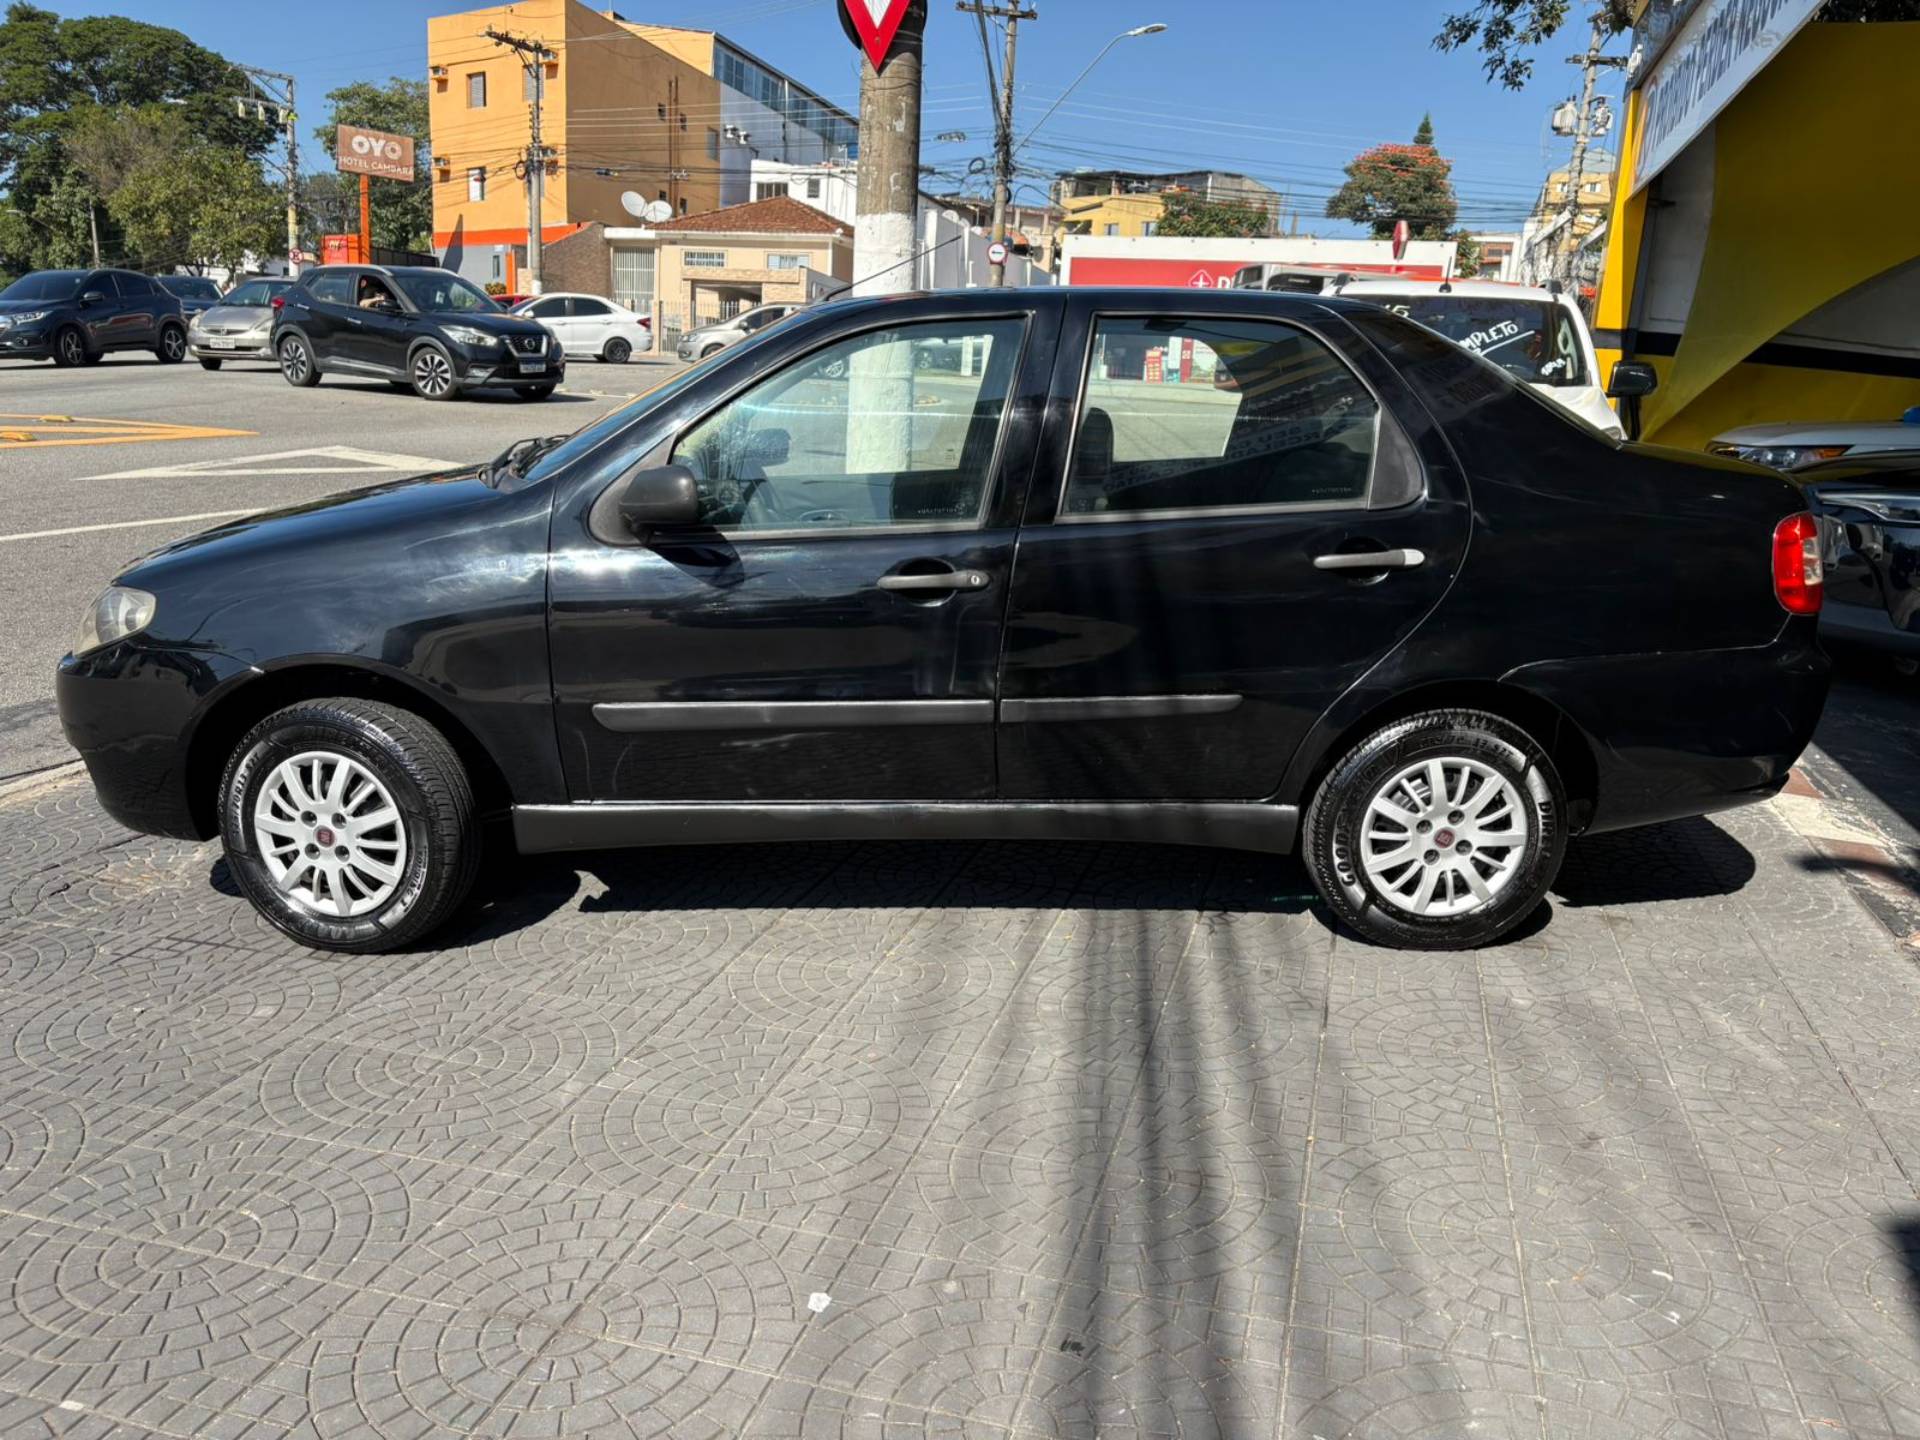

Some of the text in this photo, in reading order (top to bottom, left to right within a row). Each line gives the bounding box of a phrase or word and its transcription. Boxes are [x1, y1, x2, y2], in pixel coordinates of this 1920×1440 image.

[352, 134, 402, 160] OYO
[339, 156, 369, 169] HOTEL
[1459, 320, 1519, 351] MPLETO
